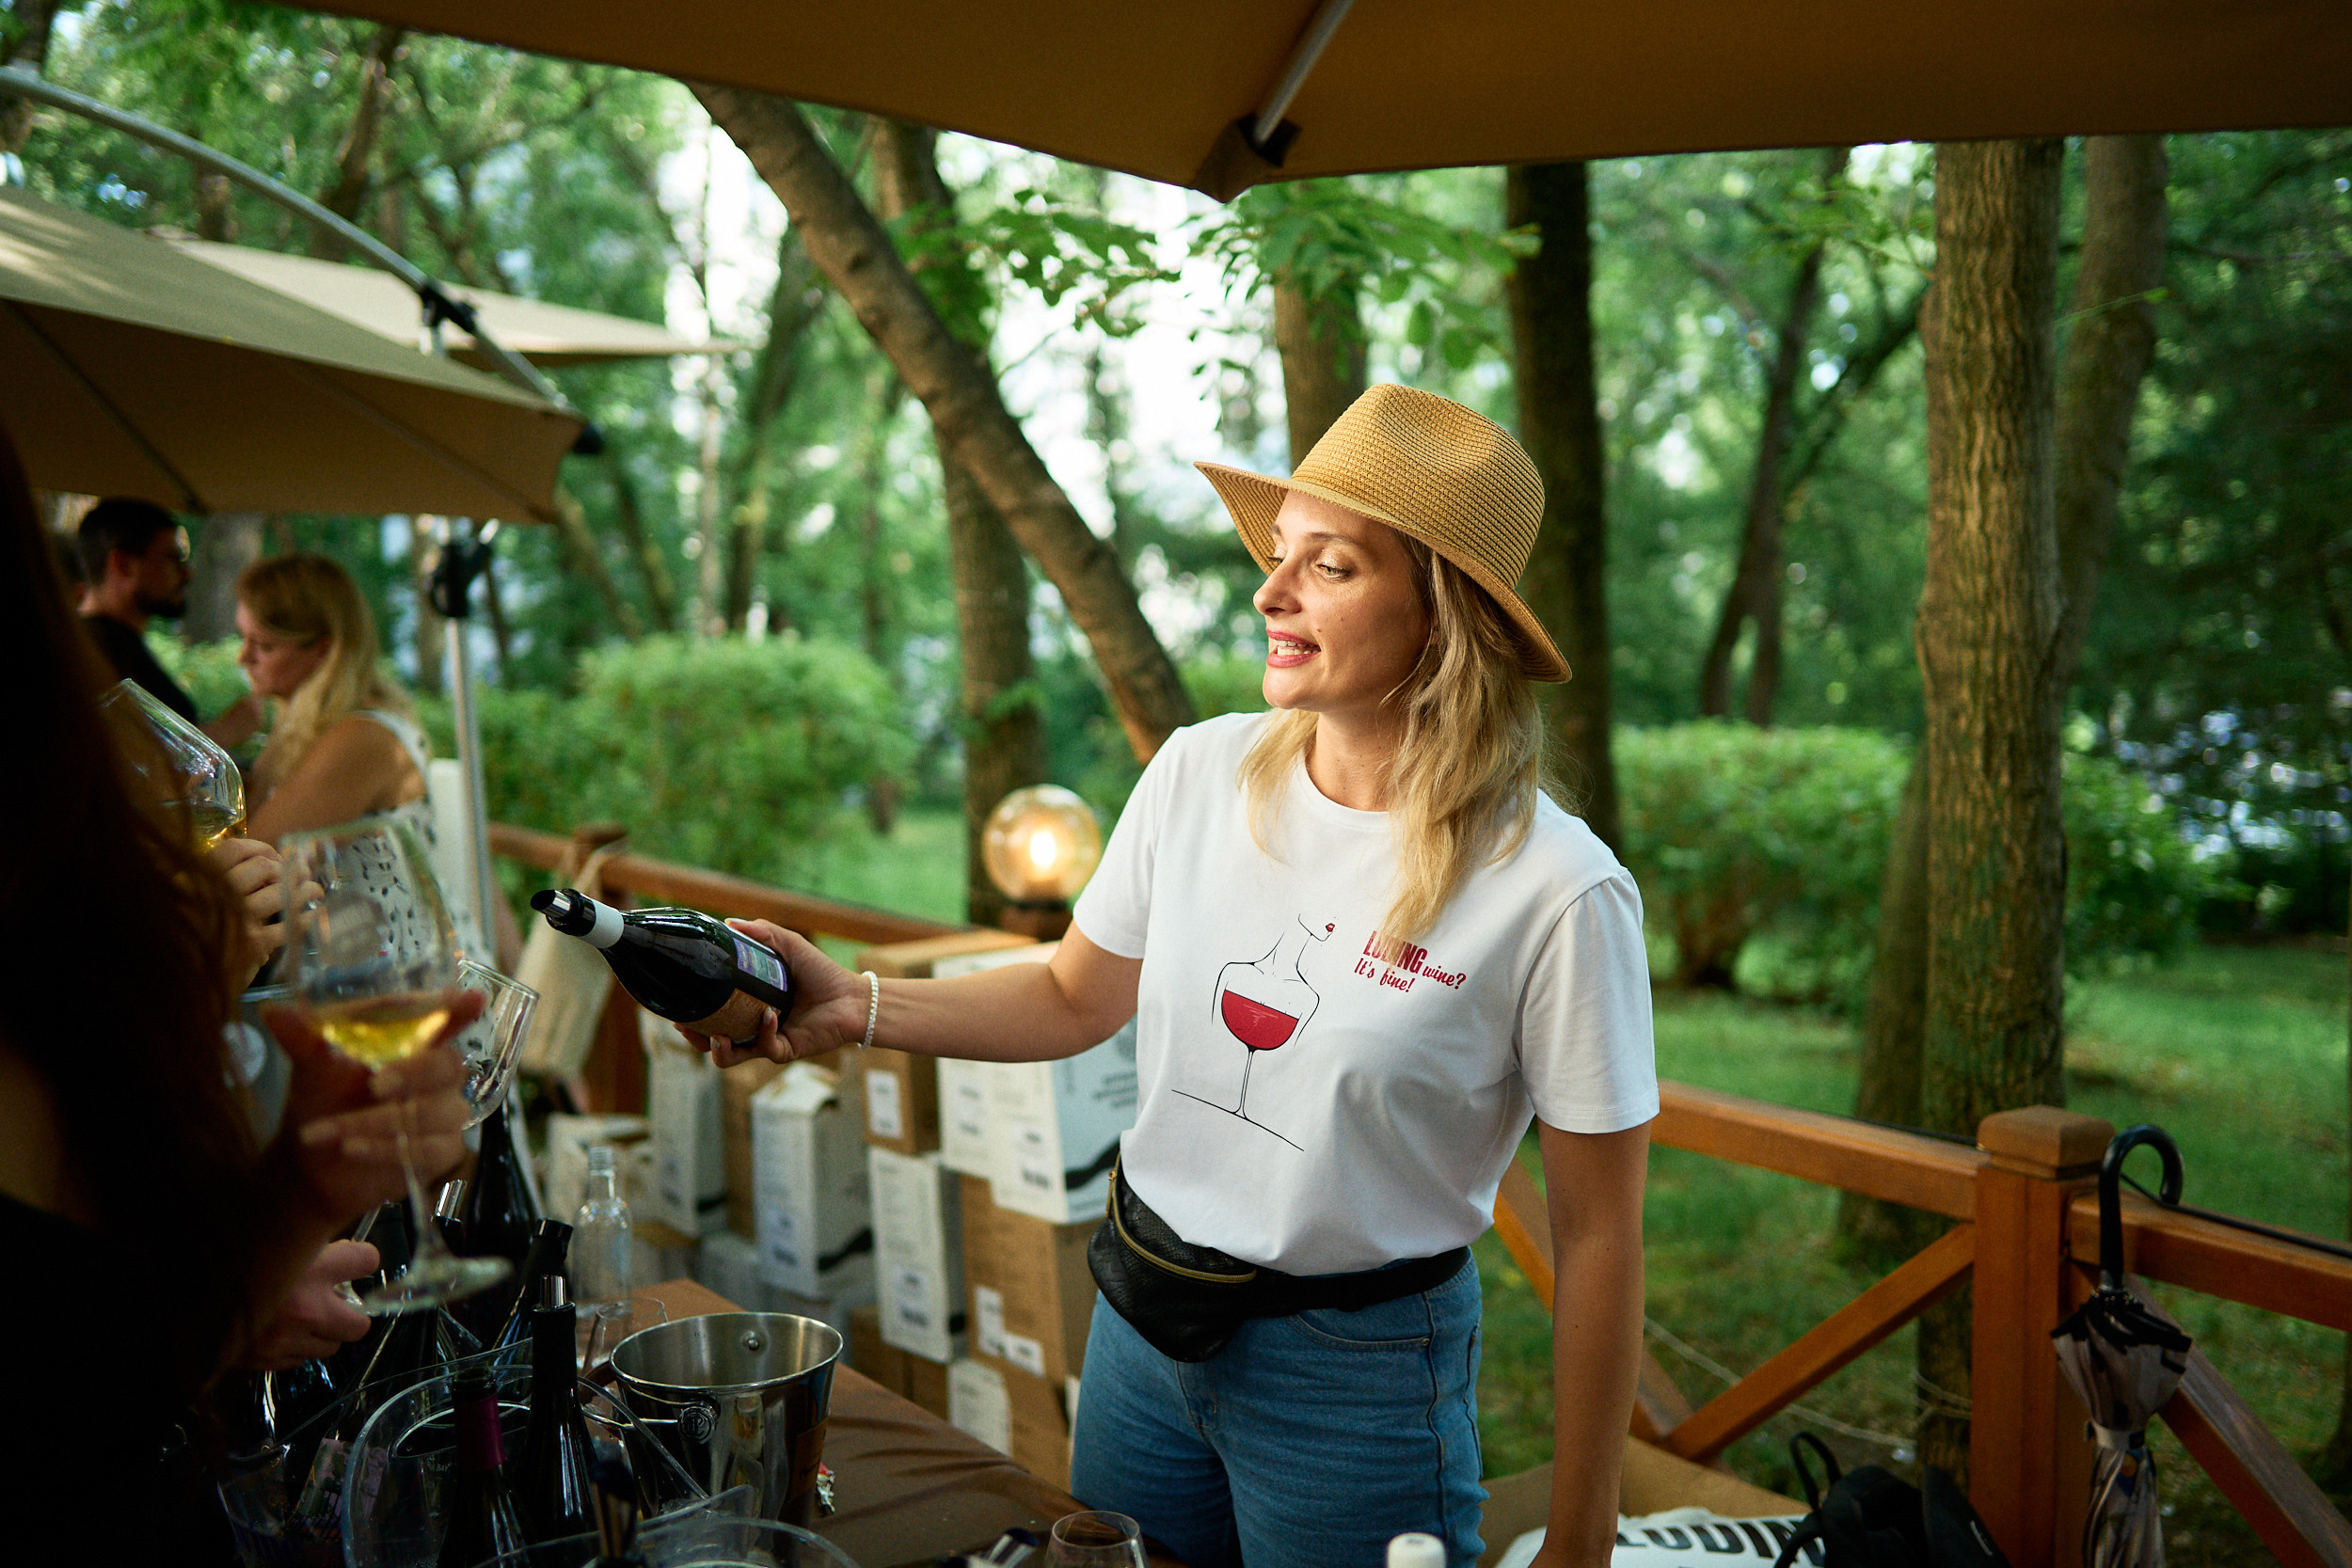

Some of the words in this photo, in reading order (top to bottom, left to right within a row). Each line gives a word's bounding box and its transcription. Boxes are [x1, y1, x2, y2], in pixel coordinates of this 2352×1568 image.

[1354, 958, 1375, 978] It's
[1379, 967, 1416, 992] fine!
[1422, 965, 1467, 990] wine?
